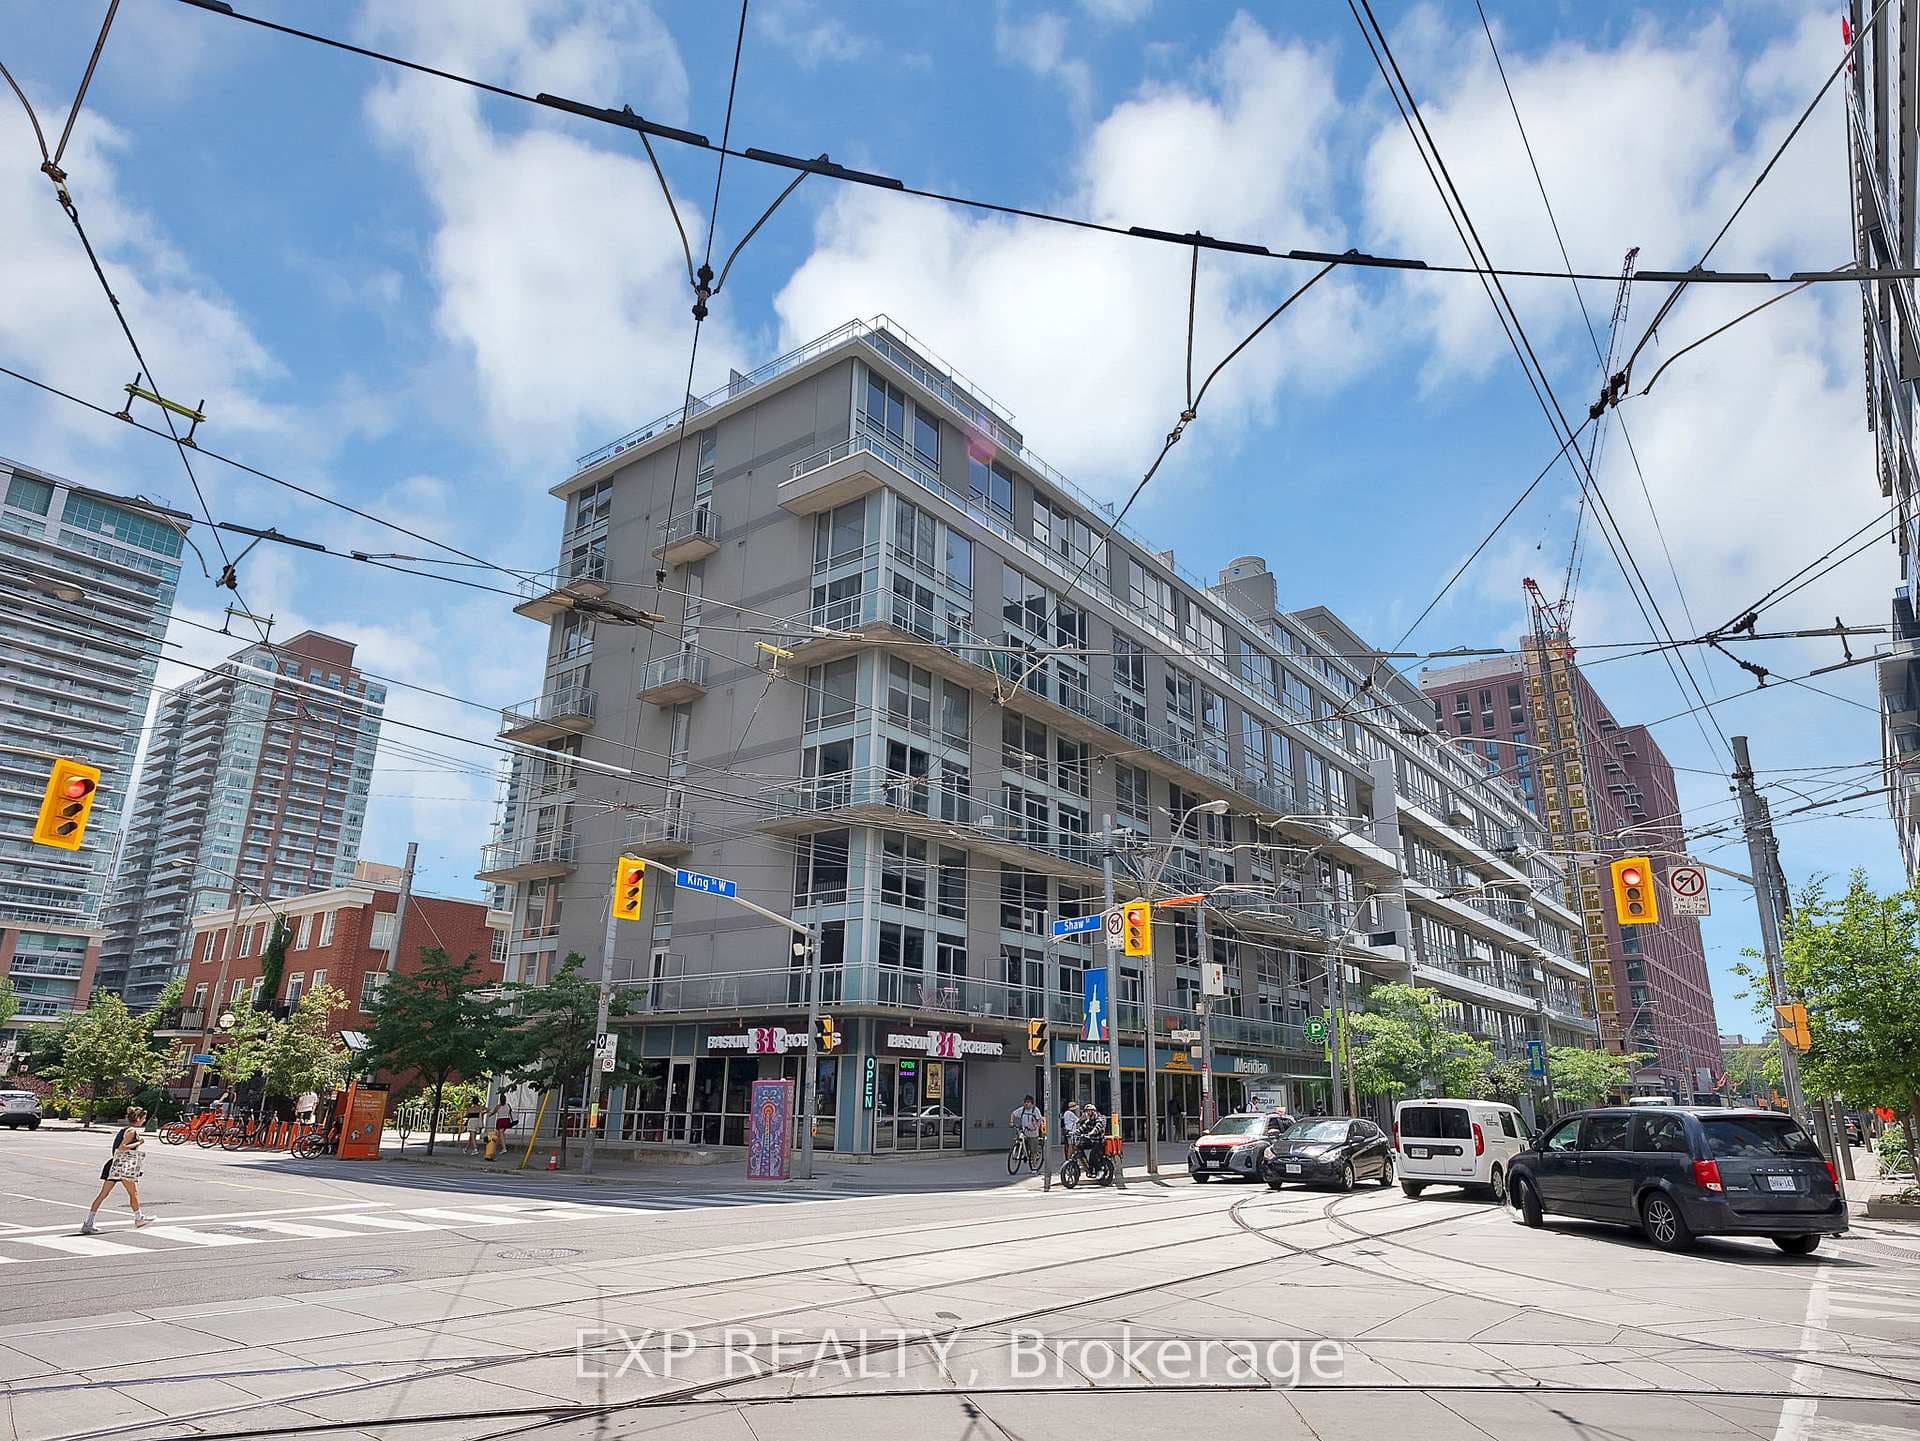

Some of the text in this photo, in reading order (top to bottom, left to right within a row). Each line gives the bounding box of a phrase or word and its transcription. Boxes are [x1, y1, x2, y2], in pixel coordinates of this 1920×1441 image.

[687, 873, 709, 891] King
[719, 880, 727, 892] W
[1064, 920, 1084, 932] Shaw
[707, 1034, 749, 1049] BASKIN
[785, 1032, 842, 1048] ROBS
[887, 1034, 931, 1050] BASKIN
[960, 1040, 1003, 1056] ROBBINS
[1066, 1043, 1111, 1065] Meridia
[900, 1061, 915, 1070] OPEN
[1234, 1057, 1268, 1074] Meridian
[864, 1058, 875, 1108] OPEN
